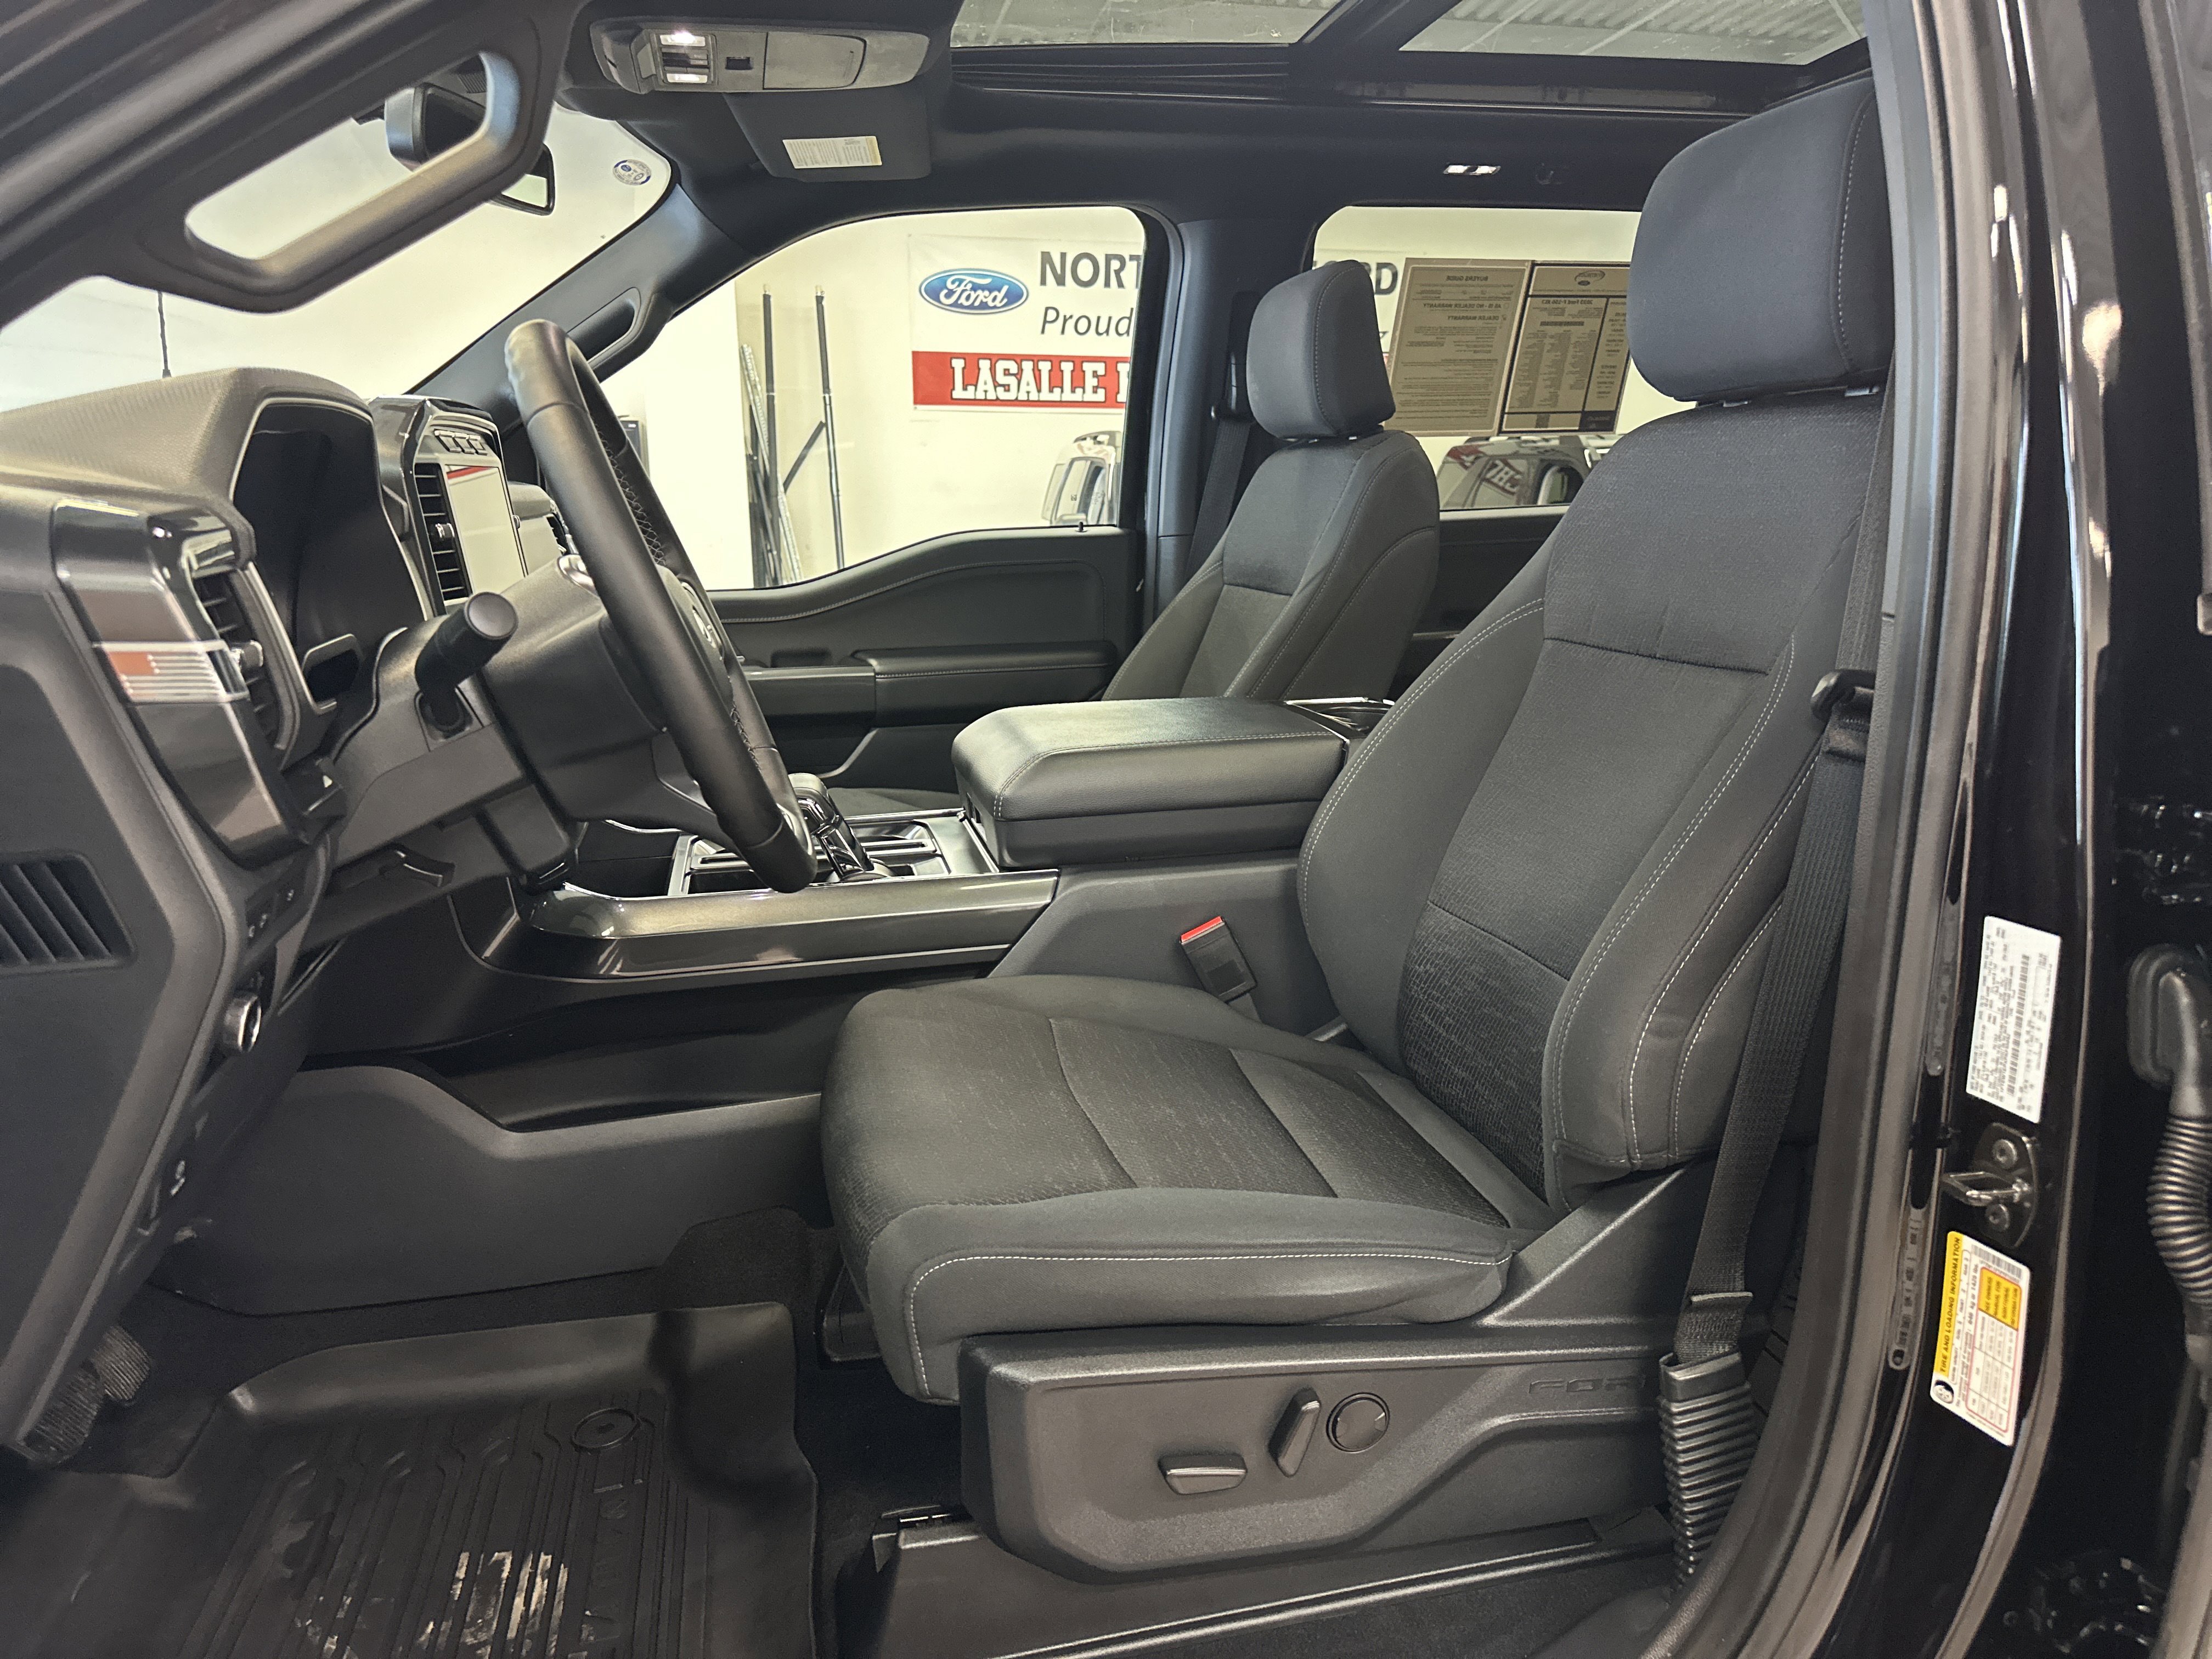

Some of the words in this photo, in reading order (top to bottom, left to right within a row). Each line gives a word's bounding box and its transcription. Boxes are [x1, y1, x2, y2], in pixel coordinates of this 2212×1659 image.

[939, 274, 1008, 308] Ford
[1041, 306, 1134, 338] Proud
[950, 357, 1107, 403] LASALLE
[1949, 1237, 1960, 1295] INFORMATION
[1945, 1295, 1954, 1334] LOADING
